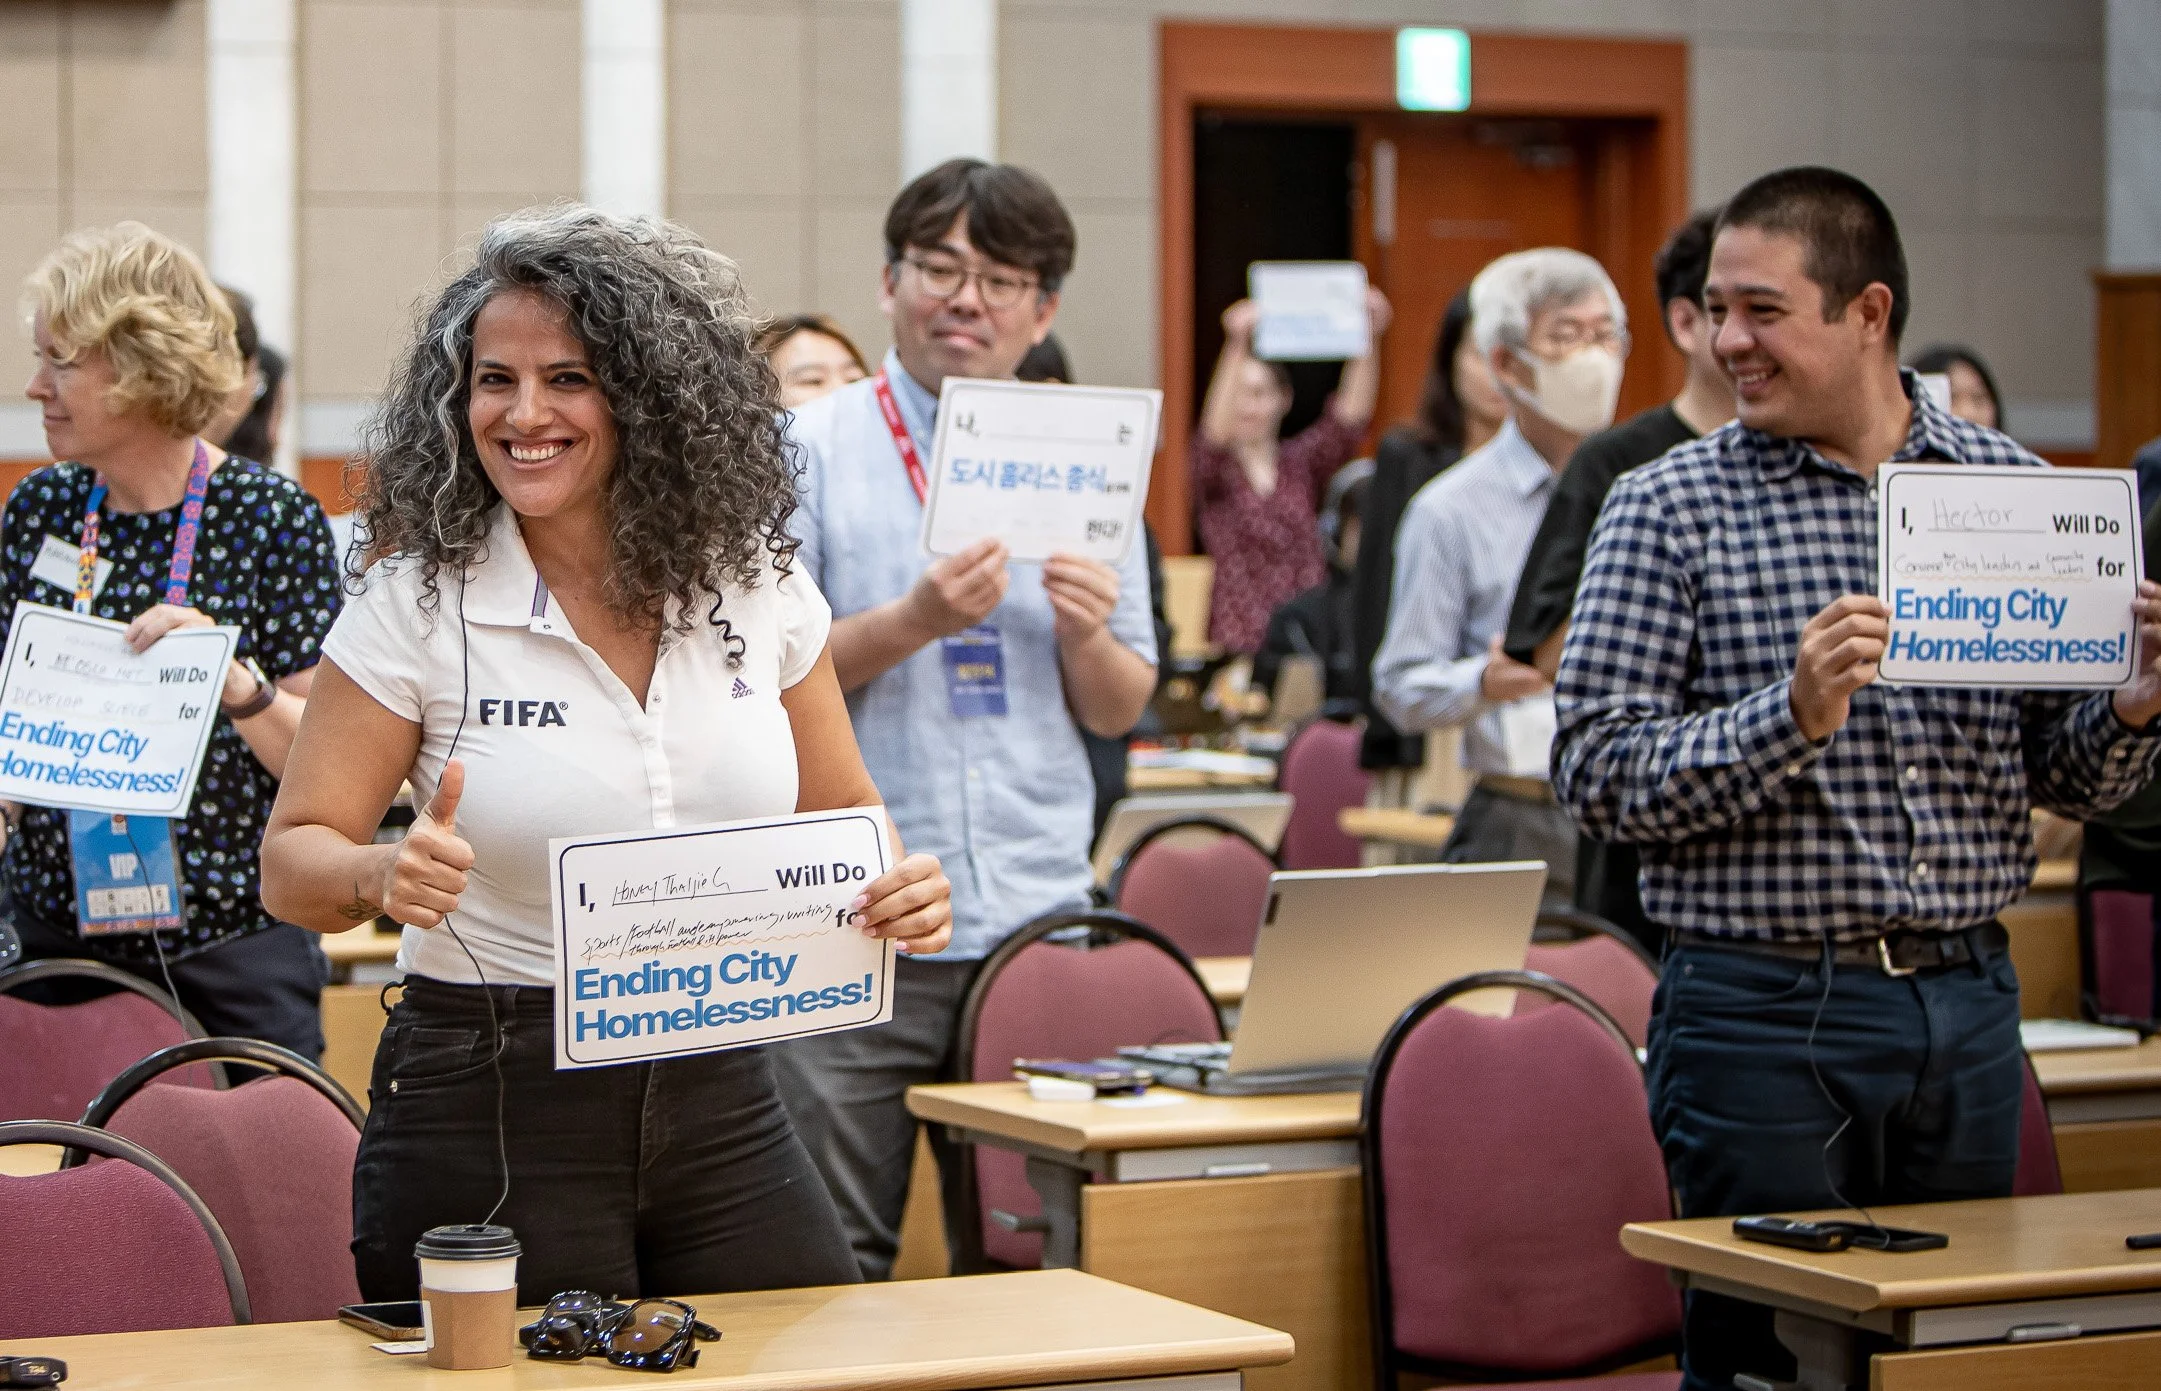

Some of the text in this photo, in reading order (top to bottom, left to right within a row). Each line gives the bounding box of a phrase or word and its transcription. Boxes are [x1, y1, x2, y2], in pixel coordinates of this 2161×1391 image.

[948, 458, 996, 489] 도시
[1901, 499, 2120, 535] I, Hector Will Do
[2097, 557, 2126, 577] for
[1895, 587, 2068, 630] Ending City
[25, 642, 35, 668] I,
[159, 667, 185, 684] Will
[188, 668, 208, 682] Do
[1889, 631, 2126, 664] Homelessness!
[179, 702, 201, 720] for
[0, 711, 149, 764] Ending City
[579, 882, 596, 912] I,
[776, 864, 826, 890] Will
[832, 862, 867, 884] Do
[575, 950, 798, 1001] Ending City
[576, 973, 873, 1042] Homelessness!
